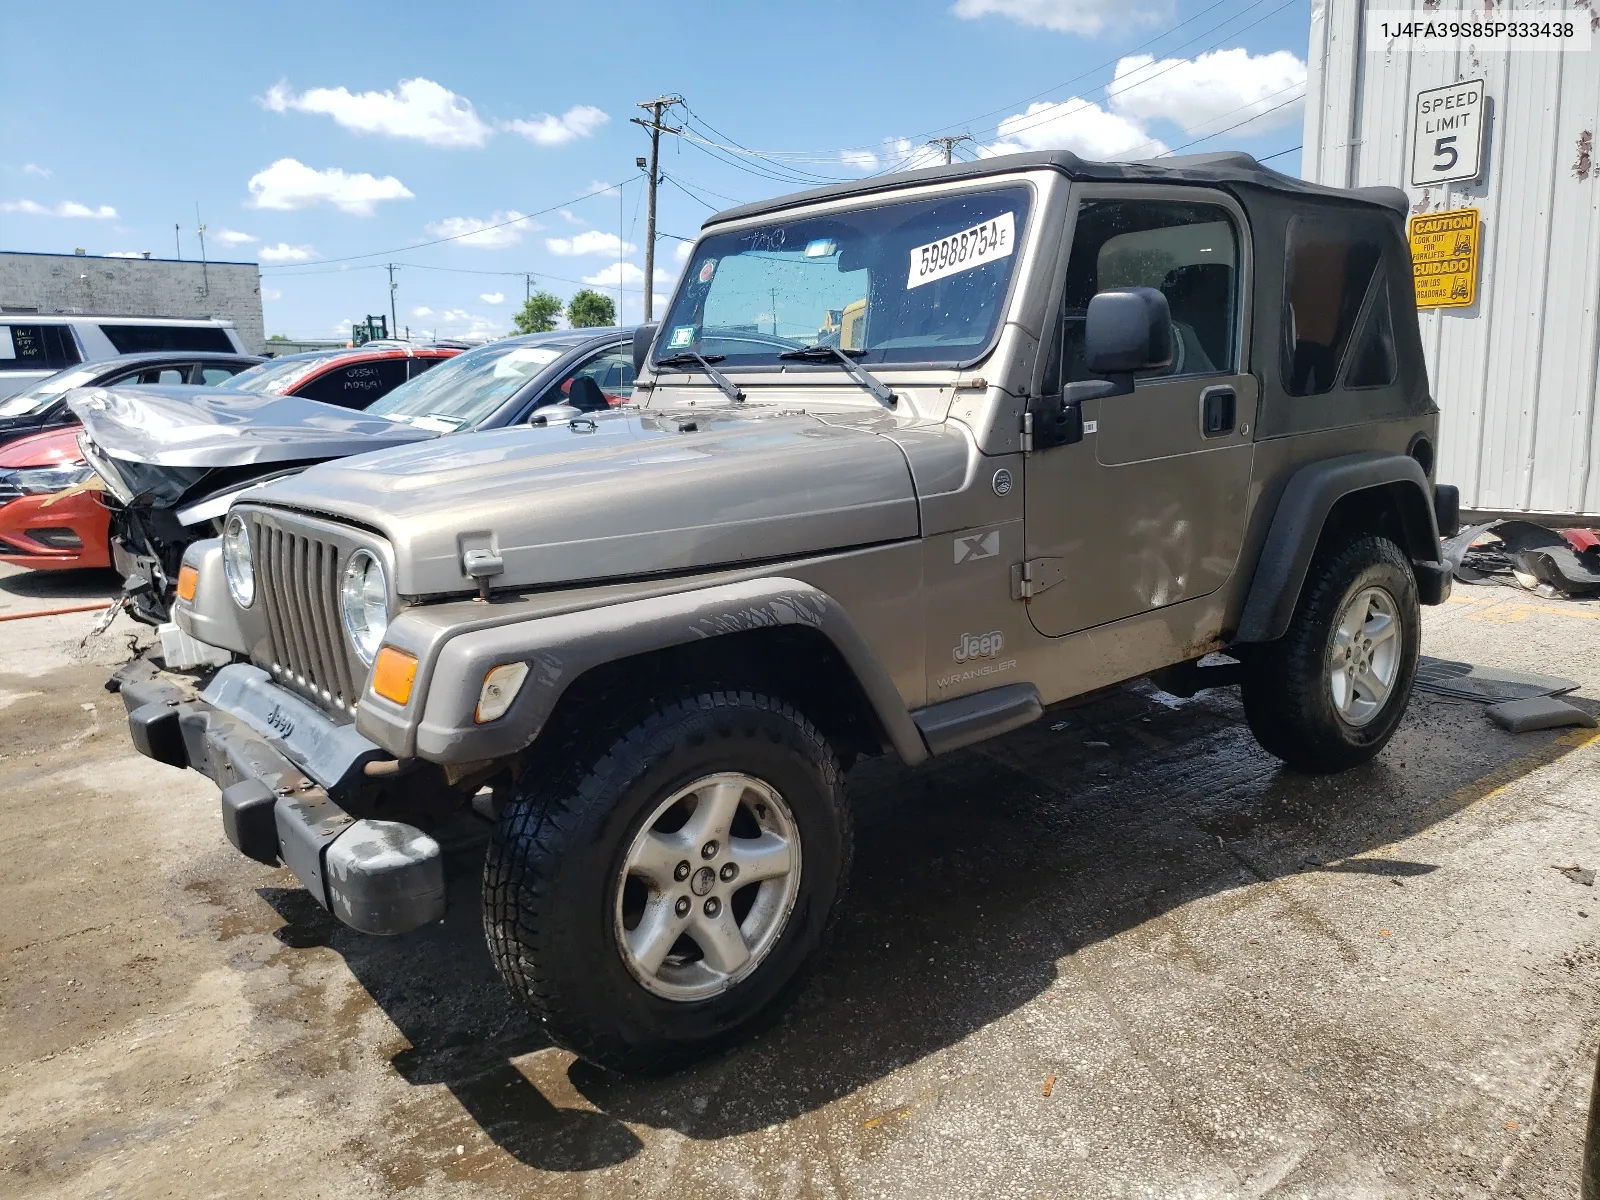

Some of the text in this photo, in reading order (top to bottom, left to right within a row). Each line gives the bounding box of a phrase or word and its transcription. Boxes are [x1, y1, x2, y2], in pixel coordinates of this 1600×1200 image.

[1421, 91, 1478, 114] SPEED
[1425, 113, 1470, 134] LIMIT
[1432, 136, 1458, 171] 5
[1415, 216, 1472, 234] CAUTION
[920, 221, 998, 276] 59988754
[1414, 236, 1430, 244] LOOK
[1413, 260, 1469, 275] CUIDADO
[1417, 279, 1441, 288] CON LOS
[1417, 289, 1447, 298] RGADORAS
[954, 633, 1003, 661] Jeep
[937, 659, 1017, 689] WRANGLER
[267, 704, 296, 740] Jeep
